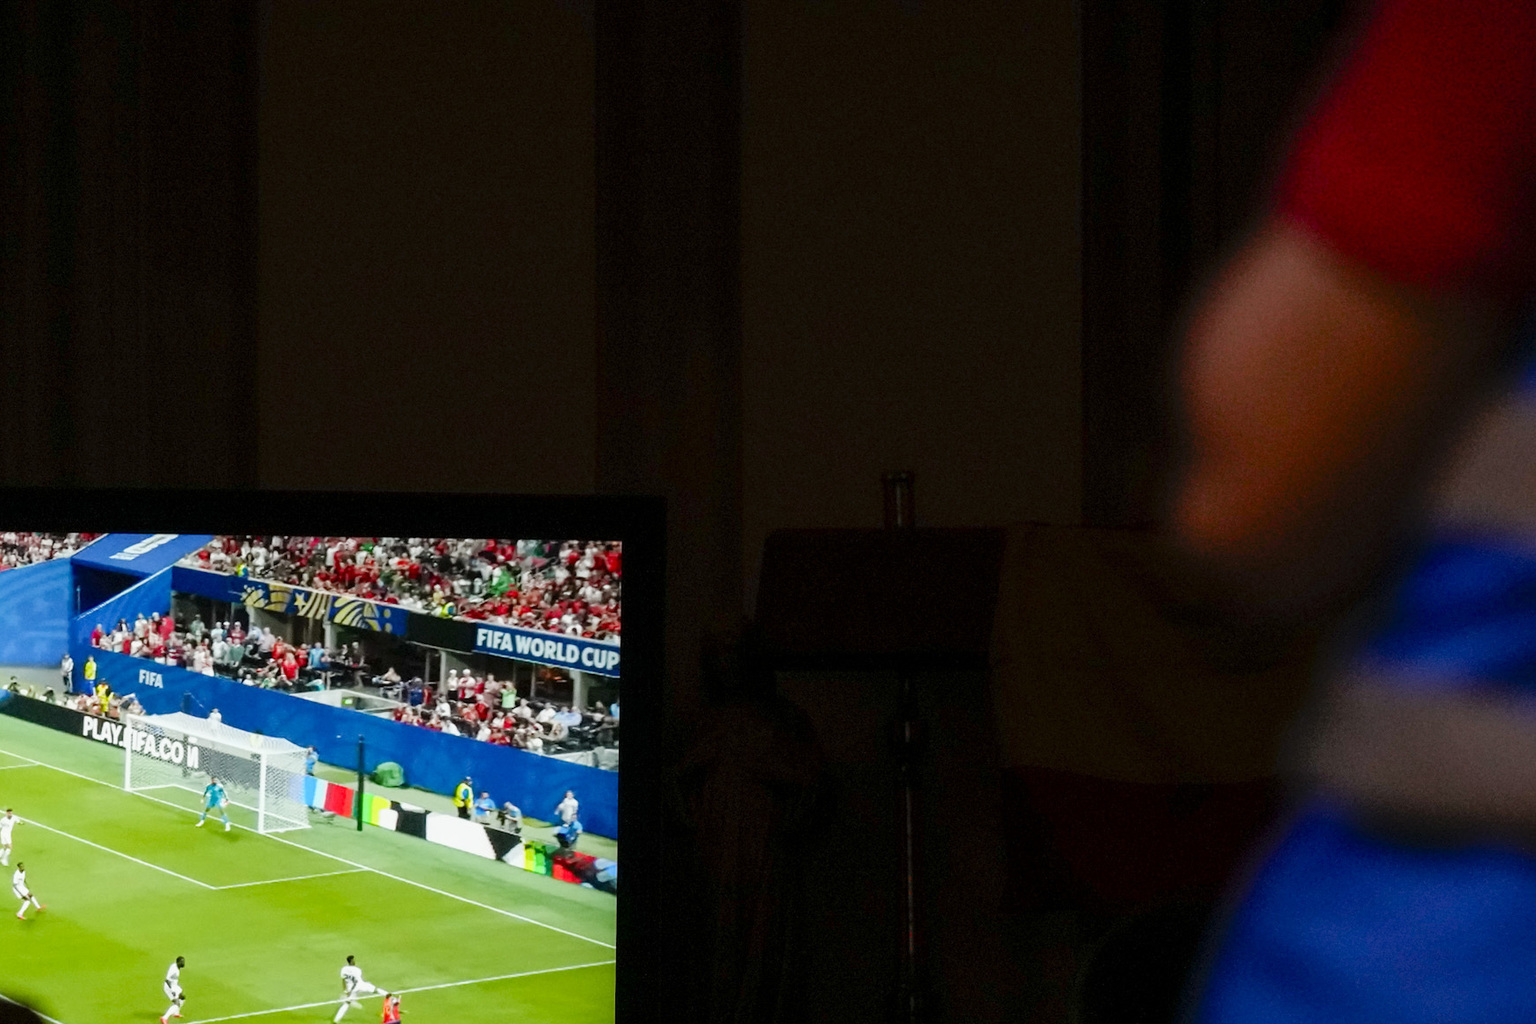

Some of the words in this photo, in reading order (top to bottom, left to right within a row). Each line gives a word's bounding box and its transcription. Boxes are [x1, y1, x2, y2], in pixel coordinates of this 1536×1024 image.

[476, 628, 513, 652] FIFA
[515, 634, 579, 663] WORLD
[581, 647, 620, 670] CUP
[139, 669, 164, 689] FIFA
